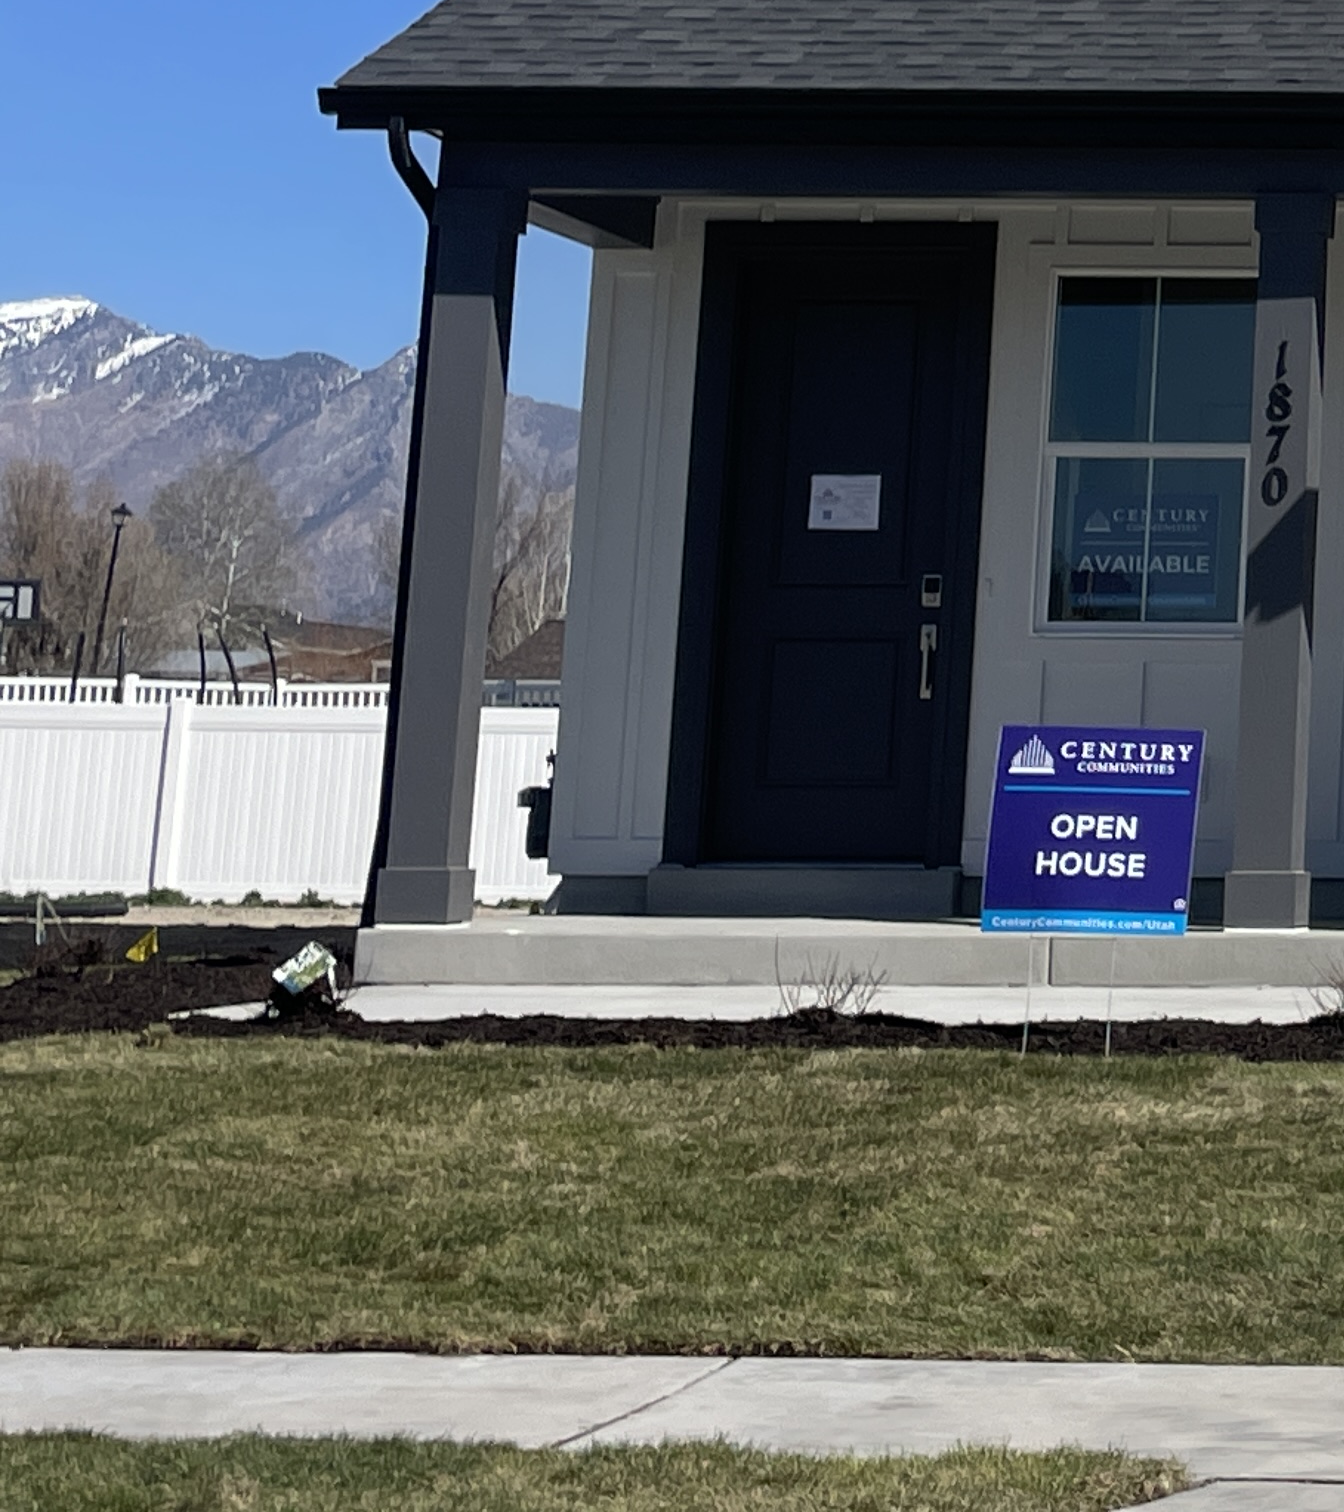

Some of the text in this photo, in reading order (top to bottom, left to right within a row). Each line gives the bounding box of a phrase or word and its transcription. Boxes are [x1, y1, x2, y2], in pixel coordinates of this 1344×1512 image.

[1261, 340, 1293, 507] 1870
[1077, 554, 1211, 574] AVAILABLE
[1059, 740, 1194, 762] CENTURY
[1076, 760, 1176, 776] COMMUNITIES
[1050, 813, 1139, 840] OPEN
[1034, 850, 1147, 878] HOUSE
[991, 915, 1176, 931] CenturyCommunities.com/Utah
